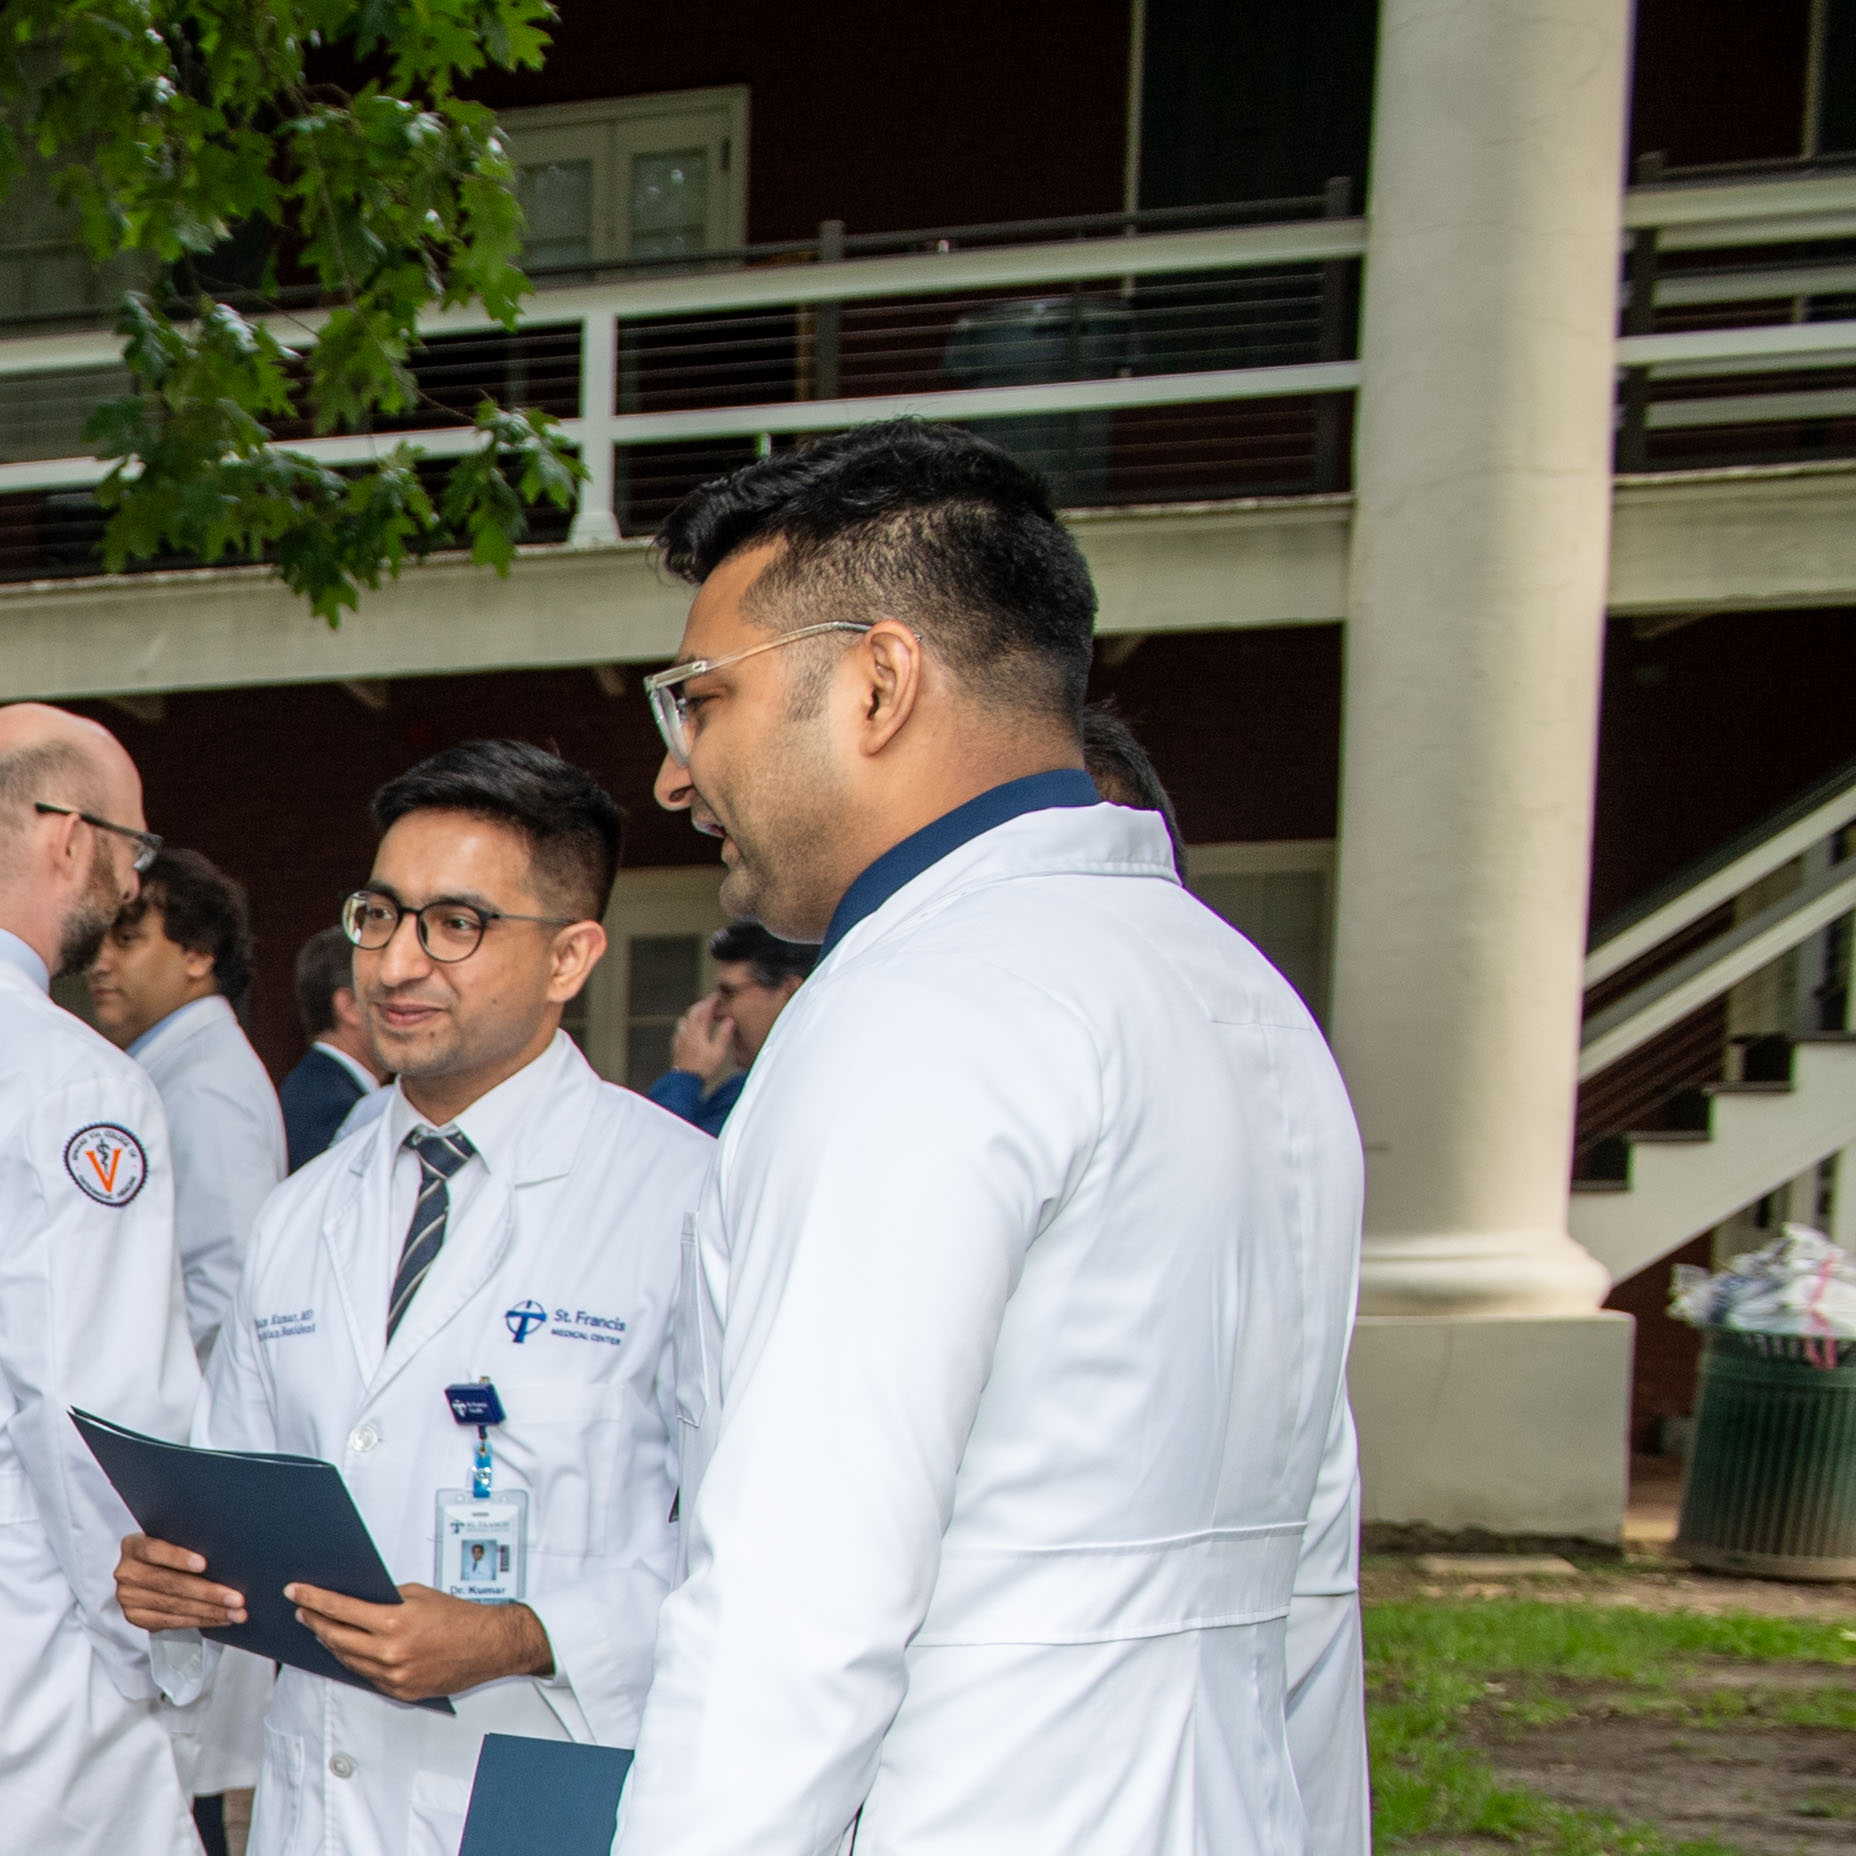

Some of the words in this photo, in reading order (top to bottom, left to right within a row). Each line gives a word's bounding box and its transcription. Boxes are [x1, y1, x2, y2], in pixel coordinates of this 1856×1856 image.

[554, 1308, 571, 1323] St.
[575, 1310, 627, 1332] Francis
[551, 1328, 589, 1340] MEDICAL
[590, 1333, 622, 1345] CENTER
[450, 1585, 465, 1595] Dr.
[468, 1585, 506, 1595] Kumar
